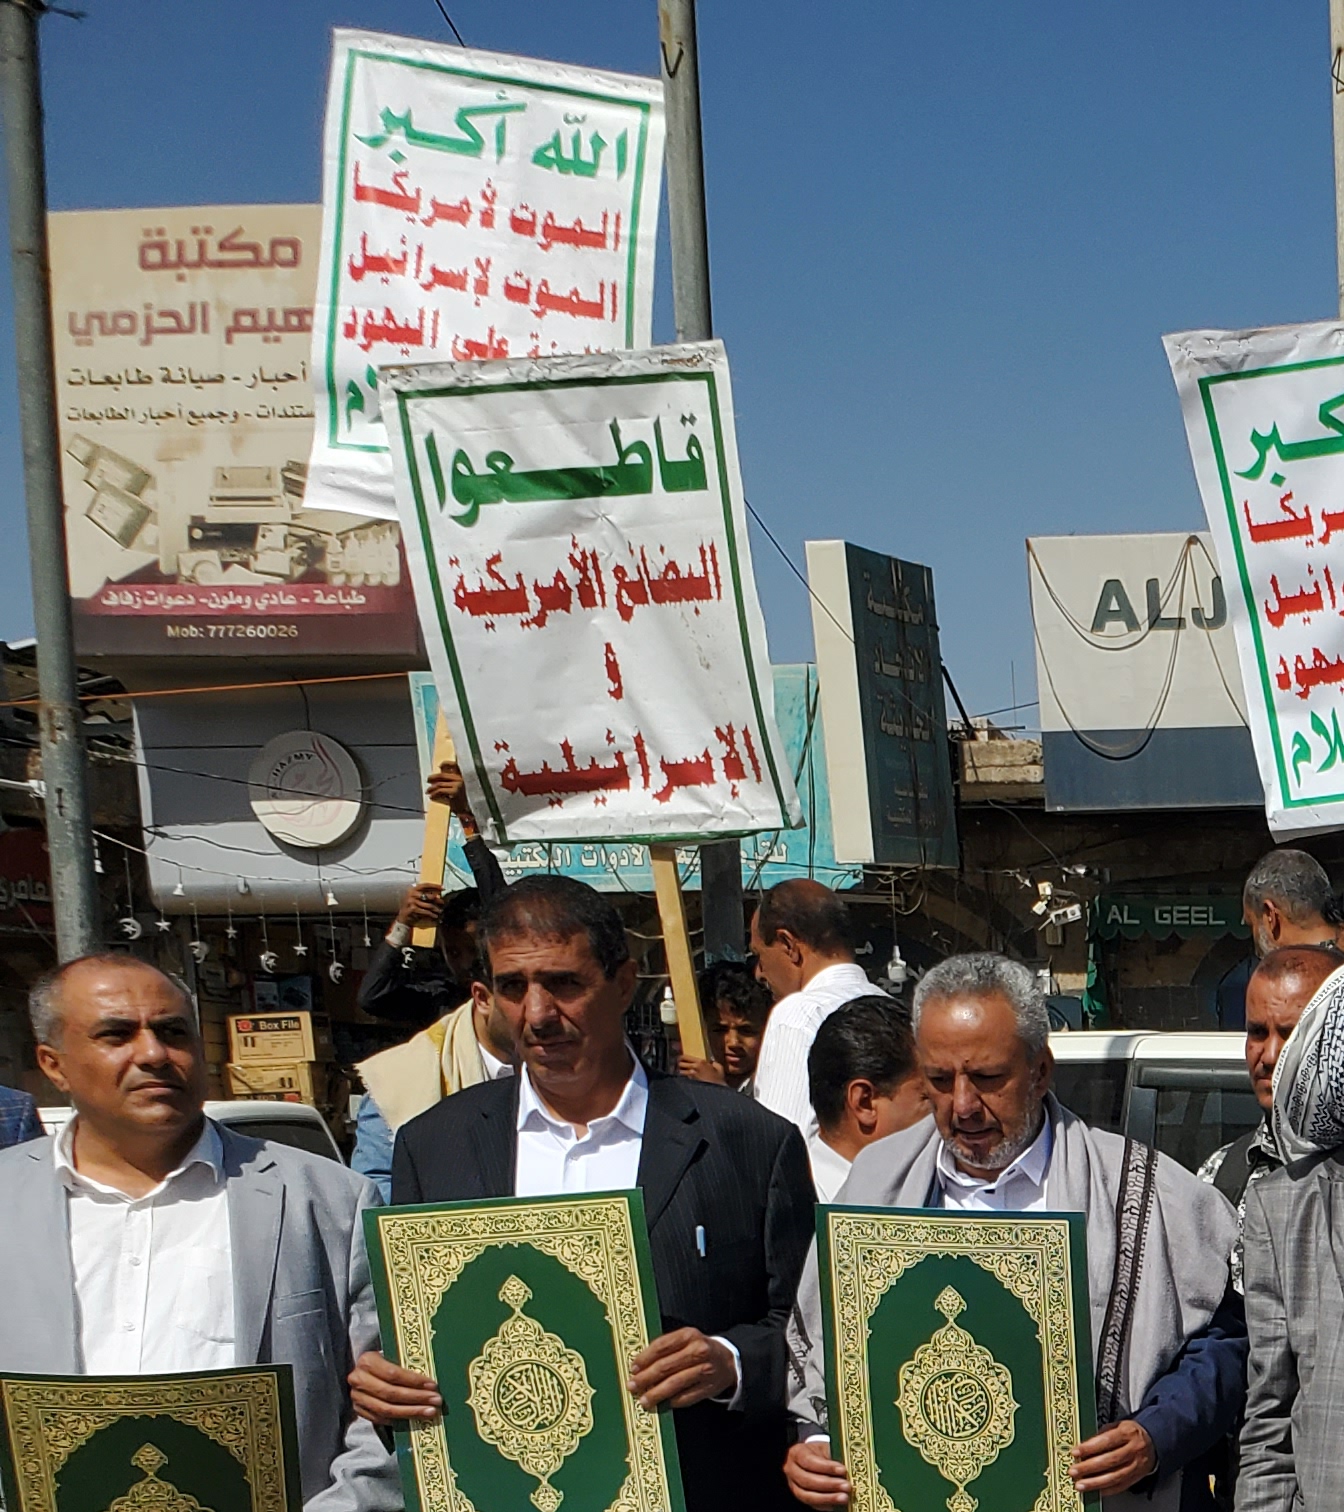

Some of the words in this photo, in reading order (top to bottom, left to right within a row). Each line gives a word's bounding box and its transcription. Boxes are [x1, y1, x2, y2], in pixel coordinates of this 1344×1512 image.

[352, 90, 527, 165] أكبر
[531, 112, 628, 180] الله
[353, 160, 497, 228] لأمريكا
[509, 202, 621, 251] الموت
[138, 225, 303, 282] مكتبة
[348, 231, 492, 307] لإسرائيل
[503, 270, 617, 323] الموت
[67, 301, 210, 346] الحزمي
[342, 305, 441, 357] اليهود
[66, 366, 154, 392] طابعات
[160, 366, 225, 389] صيانة
[66, 404, 135, 426] الطابعات
[187, 409, 238, 426] وجميع
[255, 404, 315, 421] ستندات
[424, 413, 709, 527] قاطعوا
[100, 589, 142, 609] زفاف
[145, 589, 196, 609] دعوات
[254, 589, 297, 610] عادي
[314, 589, 366, 609] طباعة
[448, 533, 607, 632] الأمريكية
[611, 540, 722, 624] البضائع
[166, 625, 204, 638] Mob:
[207, 625, 299, 638] 777260026
[604, 642, 623, 700] و
[493, 722, 763, 808] الإسرائيلية
[1107, 905, 1140, 925] AL
[1154, 906, 1226, 925] GEEL
[260, 1021, 280, 1031] Box
[281, 1019, 300, 1029] File
